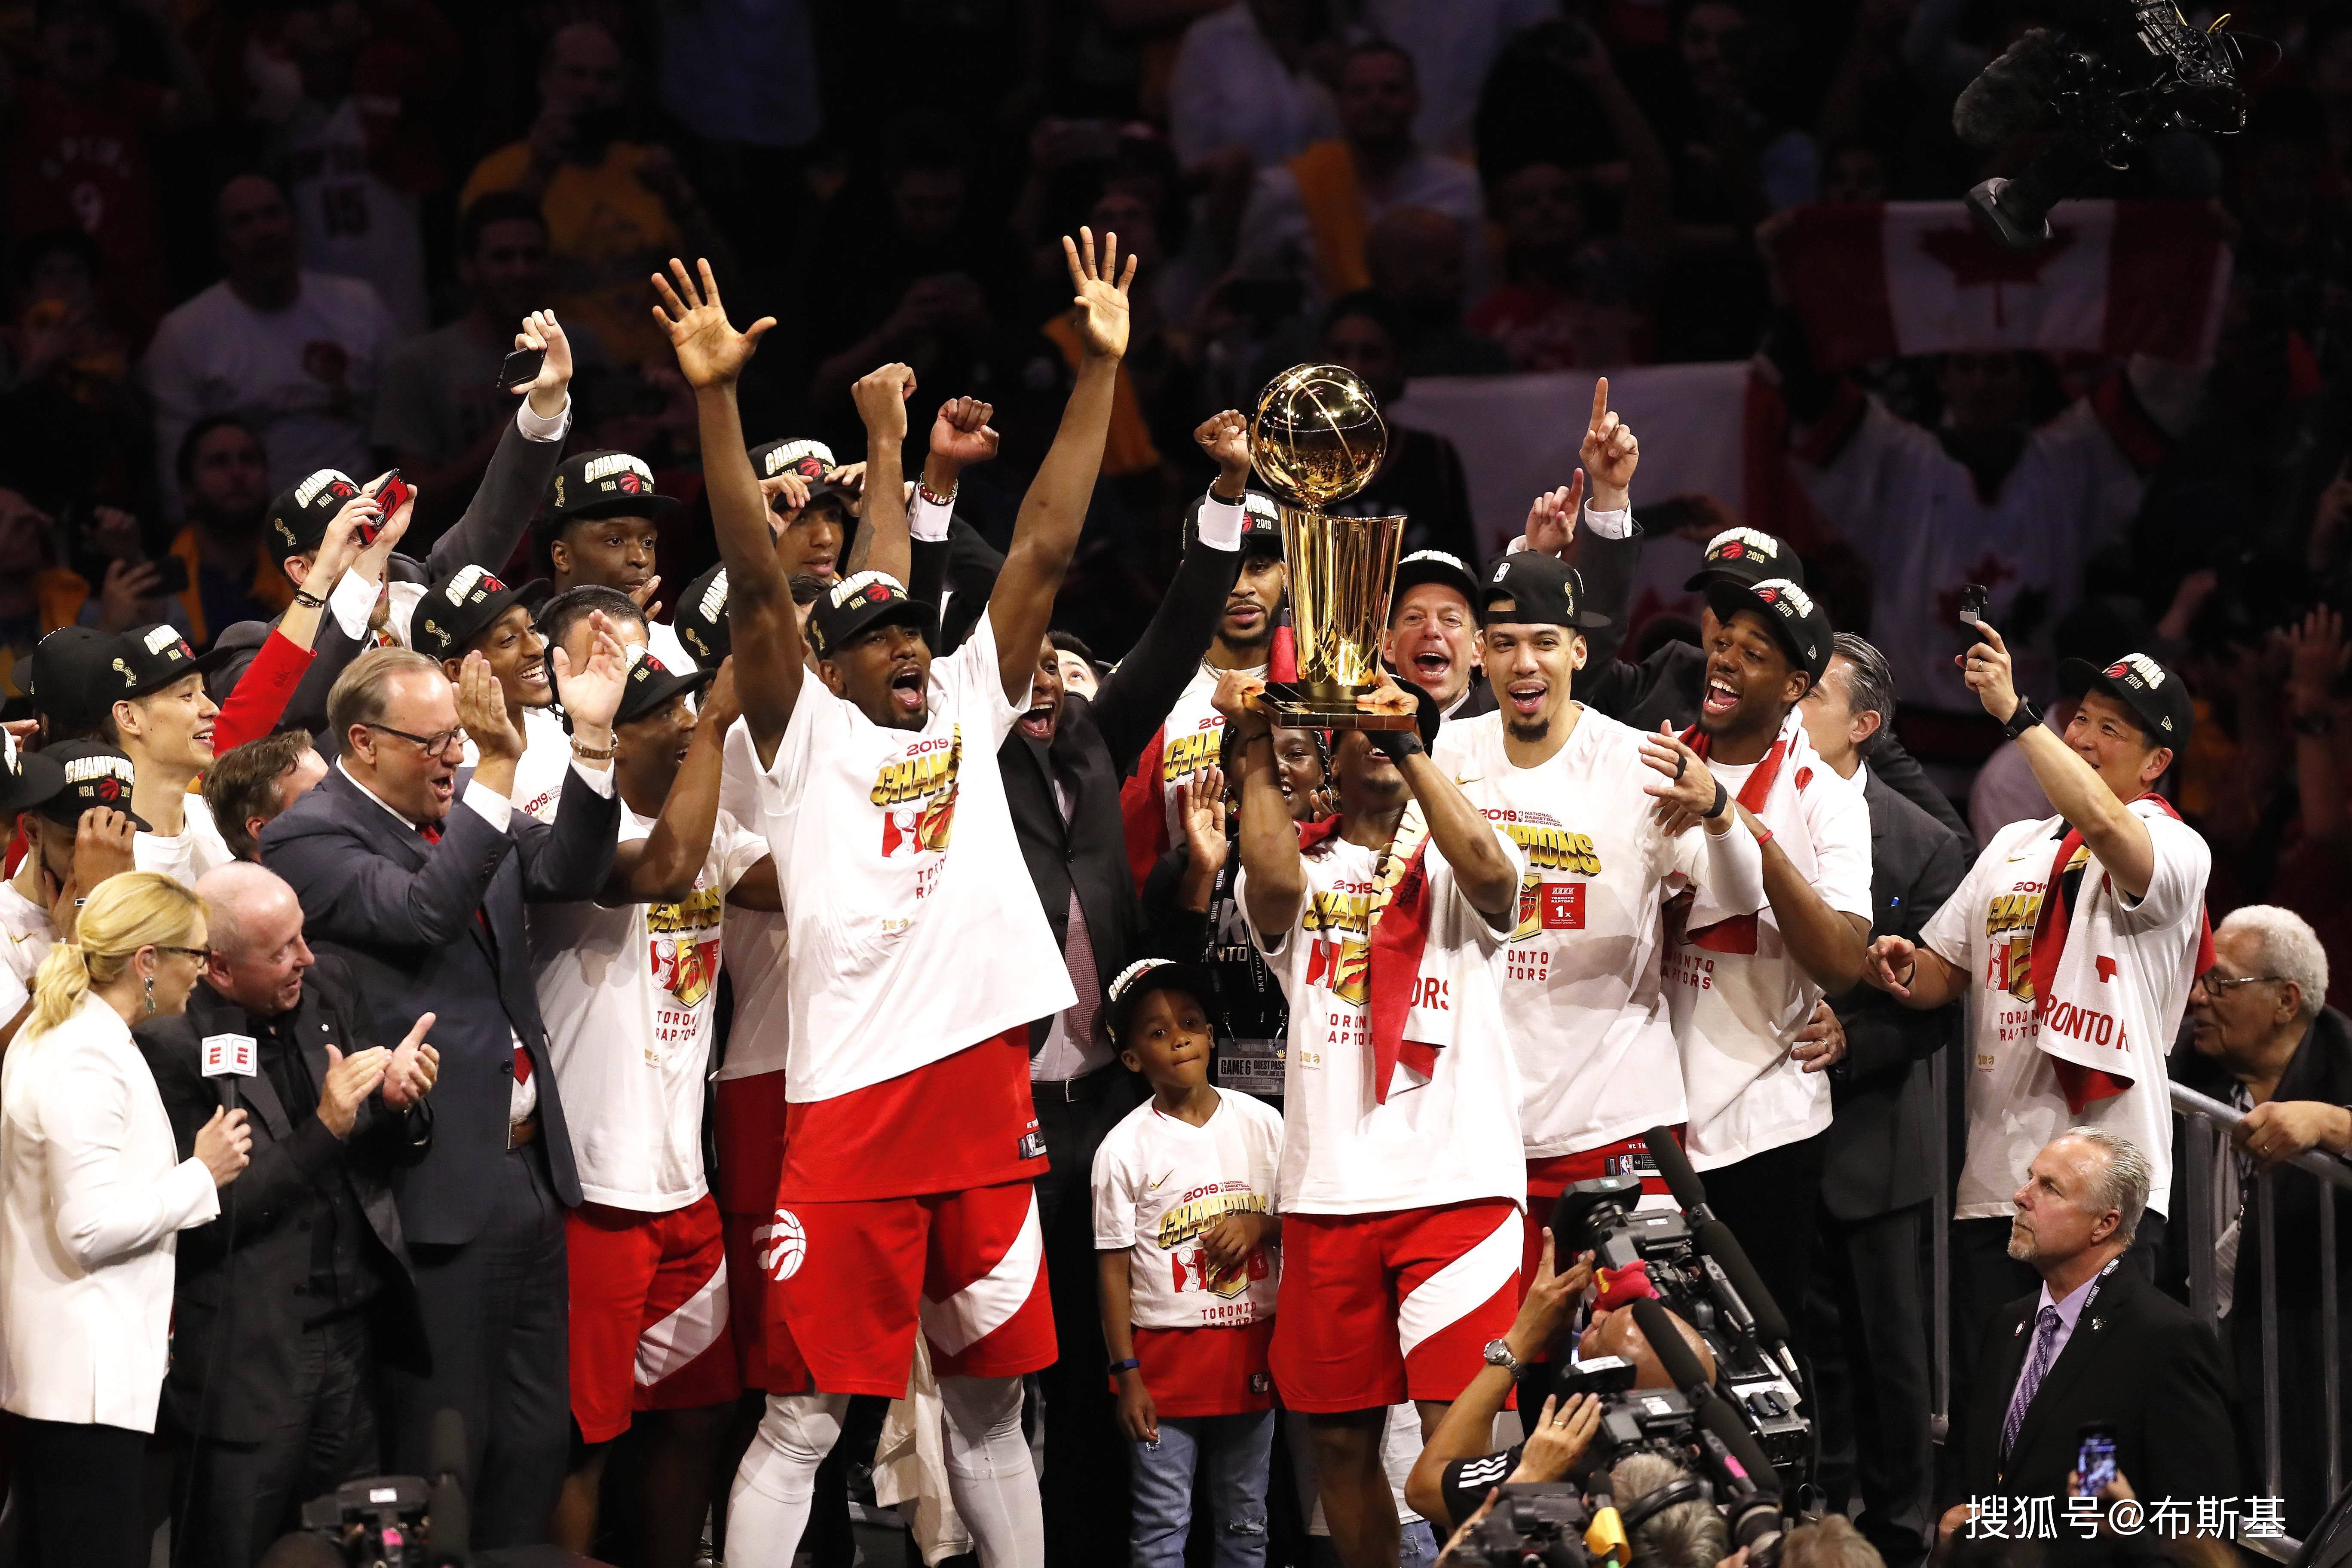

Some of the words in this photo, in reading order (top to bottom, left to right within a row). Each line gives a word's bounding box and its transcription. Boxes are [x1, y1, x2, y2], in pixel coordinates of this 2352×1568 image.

[600, 480, 617, 492] NBA
[317, 493, 334, 508] NBA
[1256, 518, 1272, 530] 2019
[1746, 550, 1765, 564] 2019
[471, 589, 488, 604] NBA
[849, 595, 867, 610] NBA
[1775, 600, 1794, 618] 2019
[167, 648, 183, 661] NBA
[634, 667, 651, 682] NBA
[2124, 674, 2144, 689] 2019
[1198, 715, 1228, 730] 20
[906, 738, 949, 756] 2019
[79, 786, 95, 797] NBA
[524, 793, 548, 816] 2019
[1479, 809, 1517, 822] 2019
[1524, 819, 1562, 827] ASSOCIATION
[1525, 815, 1560, 823] BASKETBALL
[1332, 880, 1372, 894] 2019
[1508, 949, 1548, 964] ONTO
[1257, 970, 1265, 992] DKNY
[1508, 966, 1547, 981] TORS
[1221, 1060, 1243, 1075] GAME
[1245, 1060, 1251, 1075] 6
[1253, 1060, 1269, 1070] GUEST
[1271, 1060, 1285, 1070] PASS
[1183, 1184, 1219, 1203] 2019
[2089, 1285, 2100, 1298] FINALS
[1201, 1301, 1256, 1320] TORONTO
